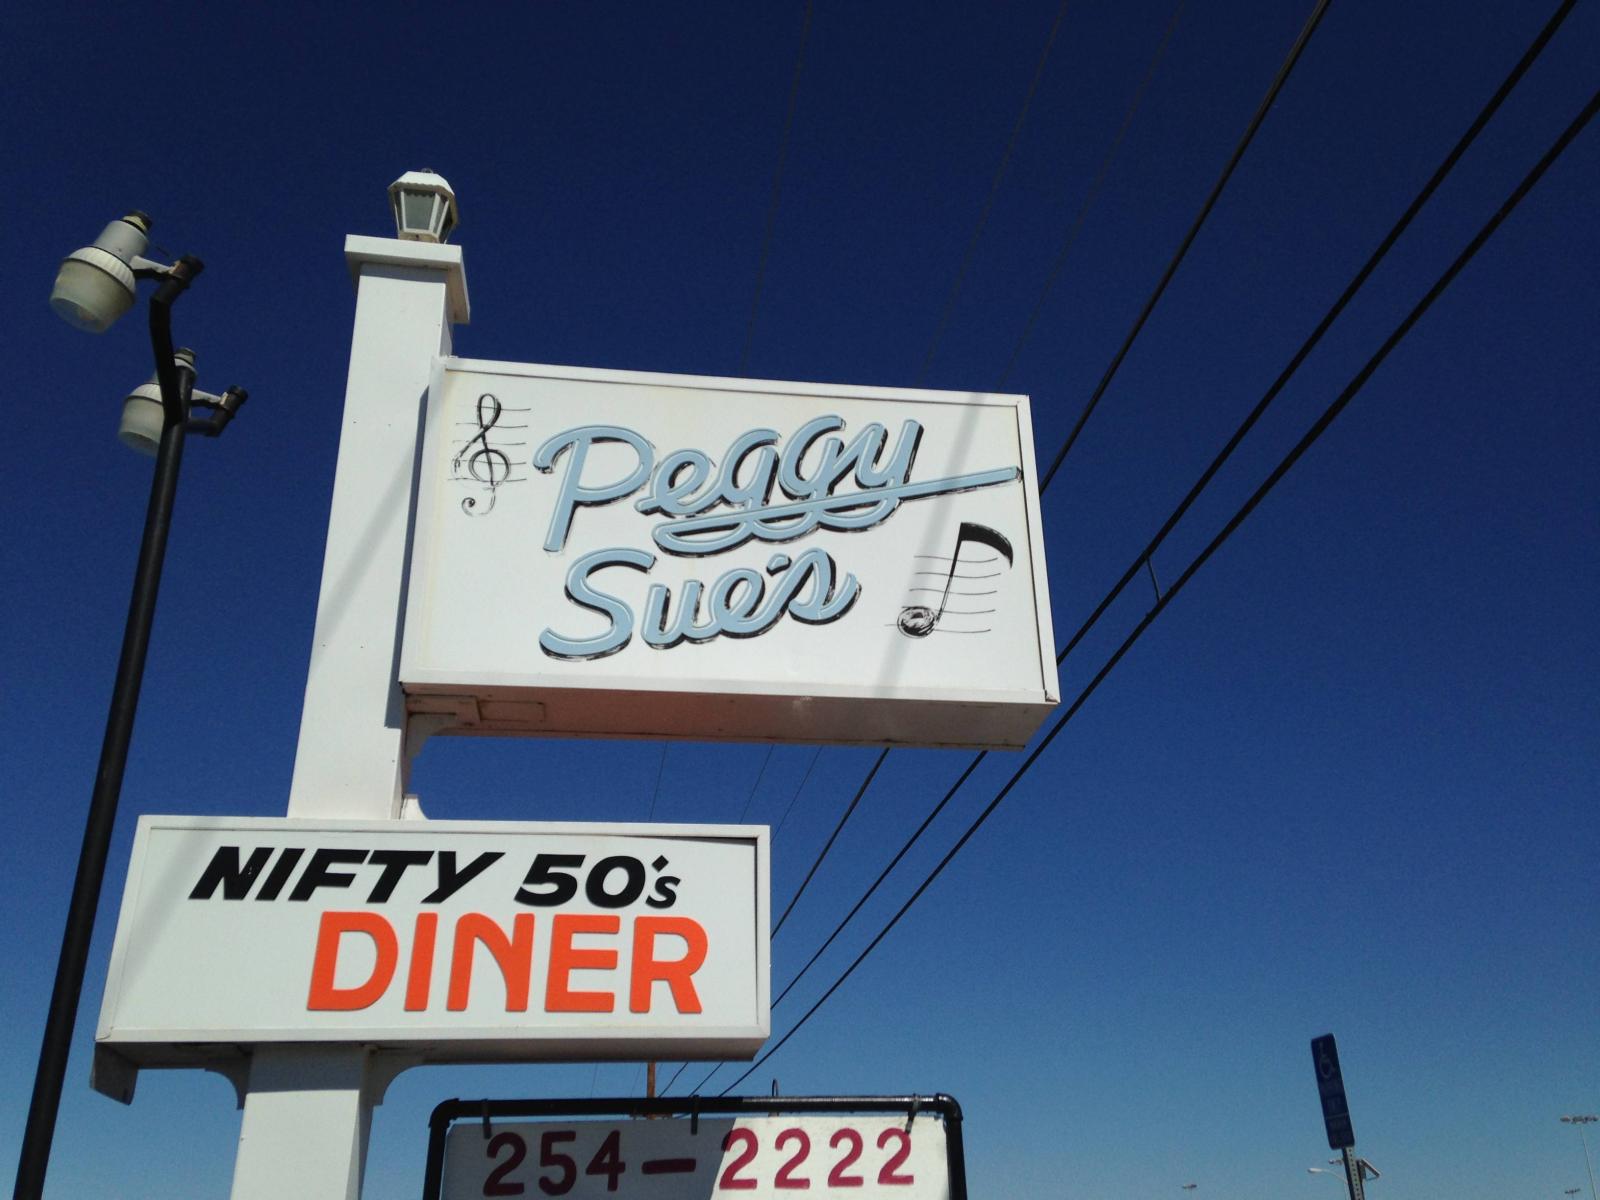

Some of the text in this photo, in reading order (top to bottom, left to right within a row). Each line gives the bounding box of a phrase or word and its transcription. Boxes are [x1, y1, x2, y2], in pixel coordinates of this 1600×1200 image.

[532, 415, 1021, 557] Peggy
[539, 547, 861, 661] Sue's
[189, 846, 681, 908] NIFTY 50's
[306, 911, 708, 1014] DINER
